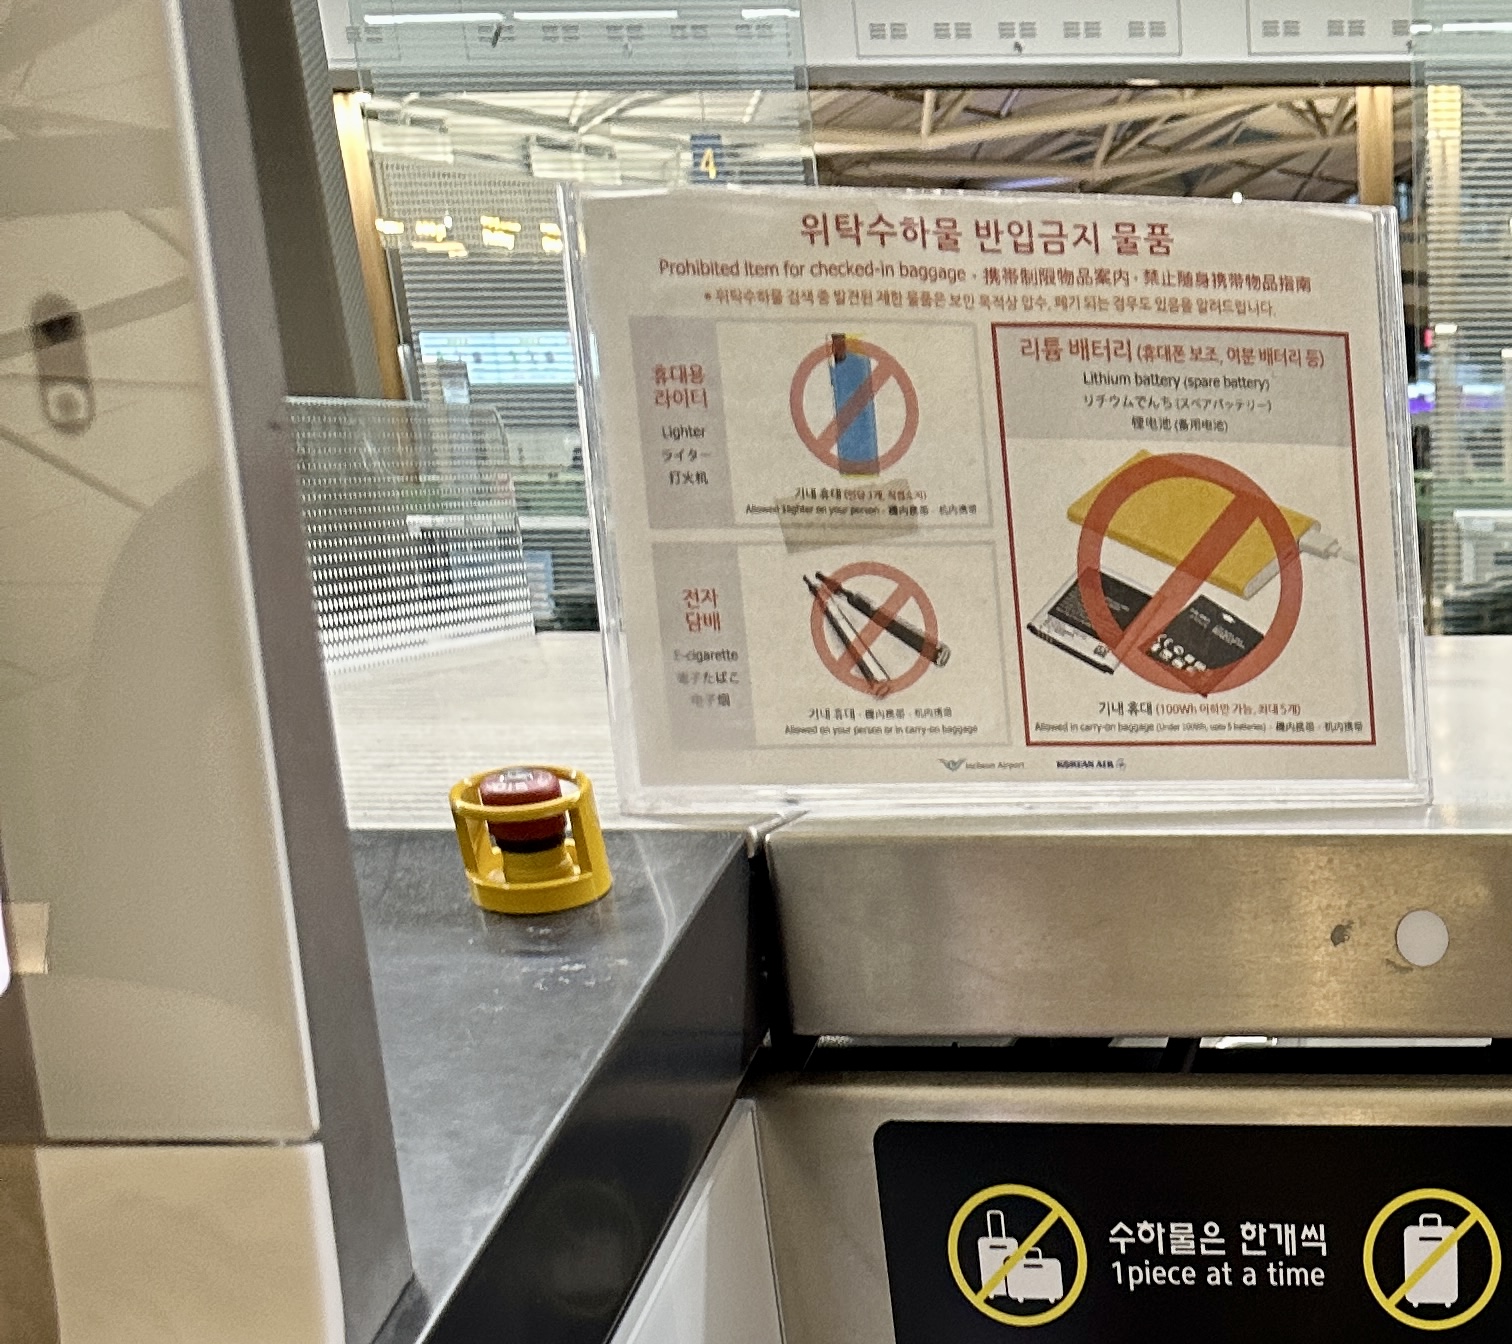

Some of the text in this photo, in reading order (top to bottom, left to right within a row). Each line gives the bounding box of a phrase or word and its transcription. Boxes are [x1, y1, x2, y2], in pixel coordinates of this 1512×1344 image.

[801, 212, 1174, 256] 위탁수하물 반입금지 물품
[659, 258, 740, 277] Prohibited
[784, 259, 804, 277] for
[809, 259, 895, 278] checked-in
[900, 260, 967, 283] baggage
[1020, 337, 1062, 362] 리튬
[1069, 338, 1132, 363] 배터리
[1259, 347, 1302, 368] 배터리
[654, 363, 705, 385] 휴대용
[1083, 371, 1270, 392] Lithium battery (spare battery)
[654, 387, 709, 409] 라이터
[661, 425, 706, 441] Lighter
[682, 588, 718, 609] 전자
[685, 611, 721, 633] 담배
[1108, 1220, 1327, 1256] 수하물은 한개씩
[1111, 1260, 1326, 1292] 1piece at a time
